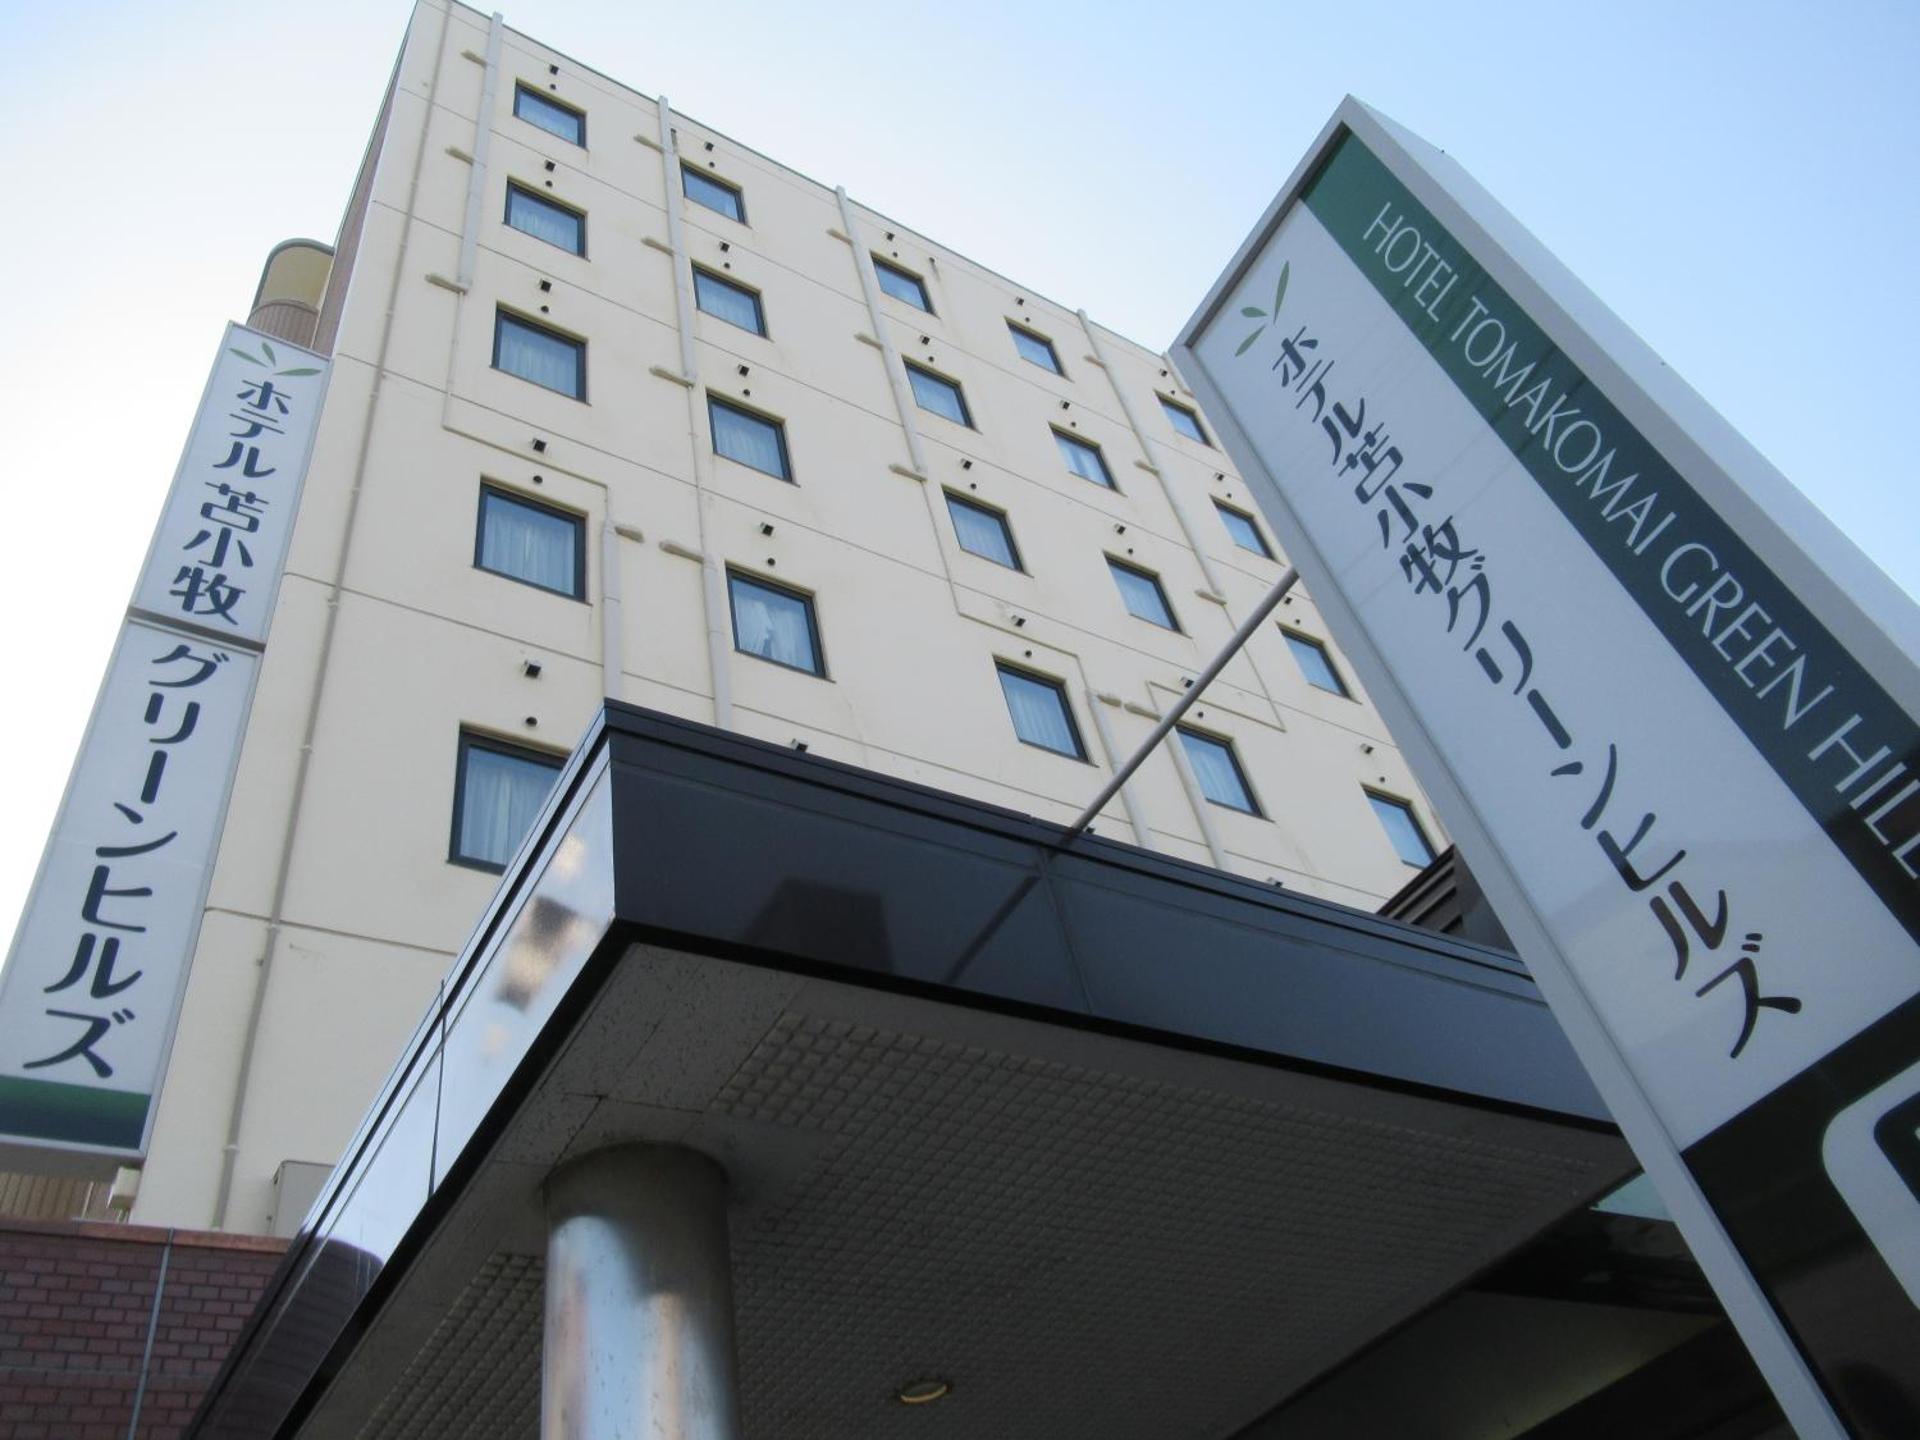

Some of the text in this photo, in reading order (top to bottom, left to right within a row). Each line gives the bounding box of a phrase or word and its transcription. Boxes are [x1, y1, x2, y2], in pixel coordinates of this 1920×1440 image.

[1362, 201, 1460, 324] HOTEL
[1454, 295, 1678, 556] TOMAKOMAI
[1660, 542, 1835, 731] GREEN
